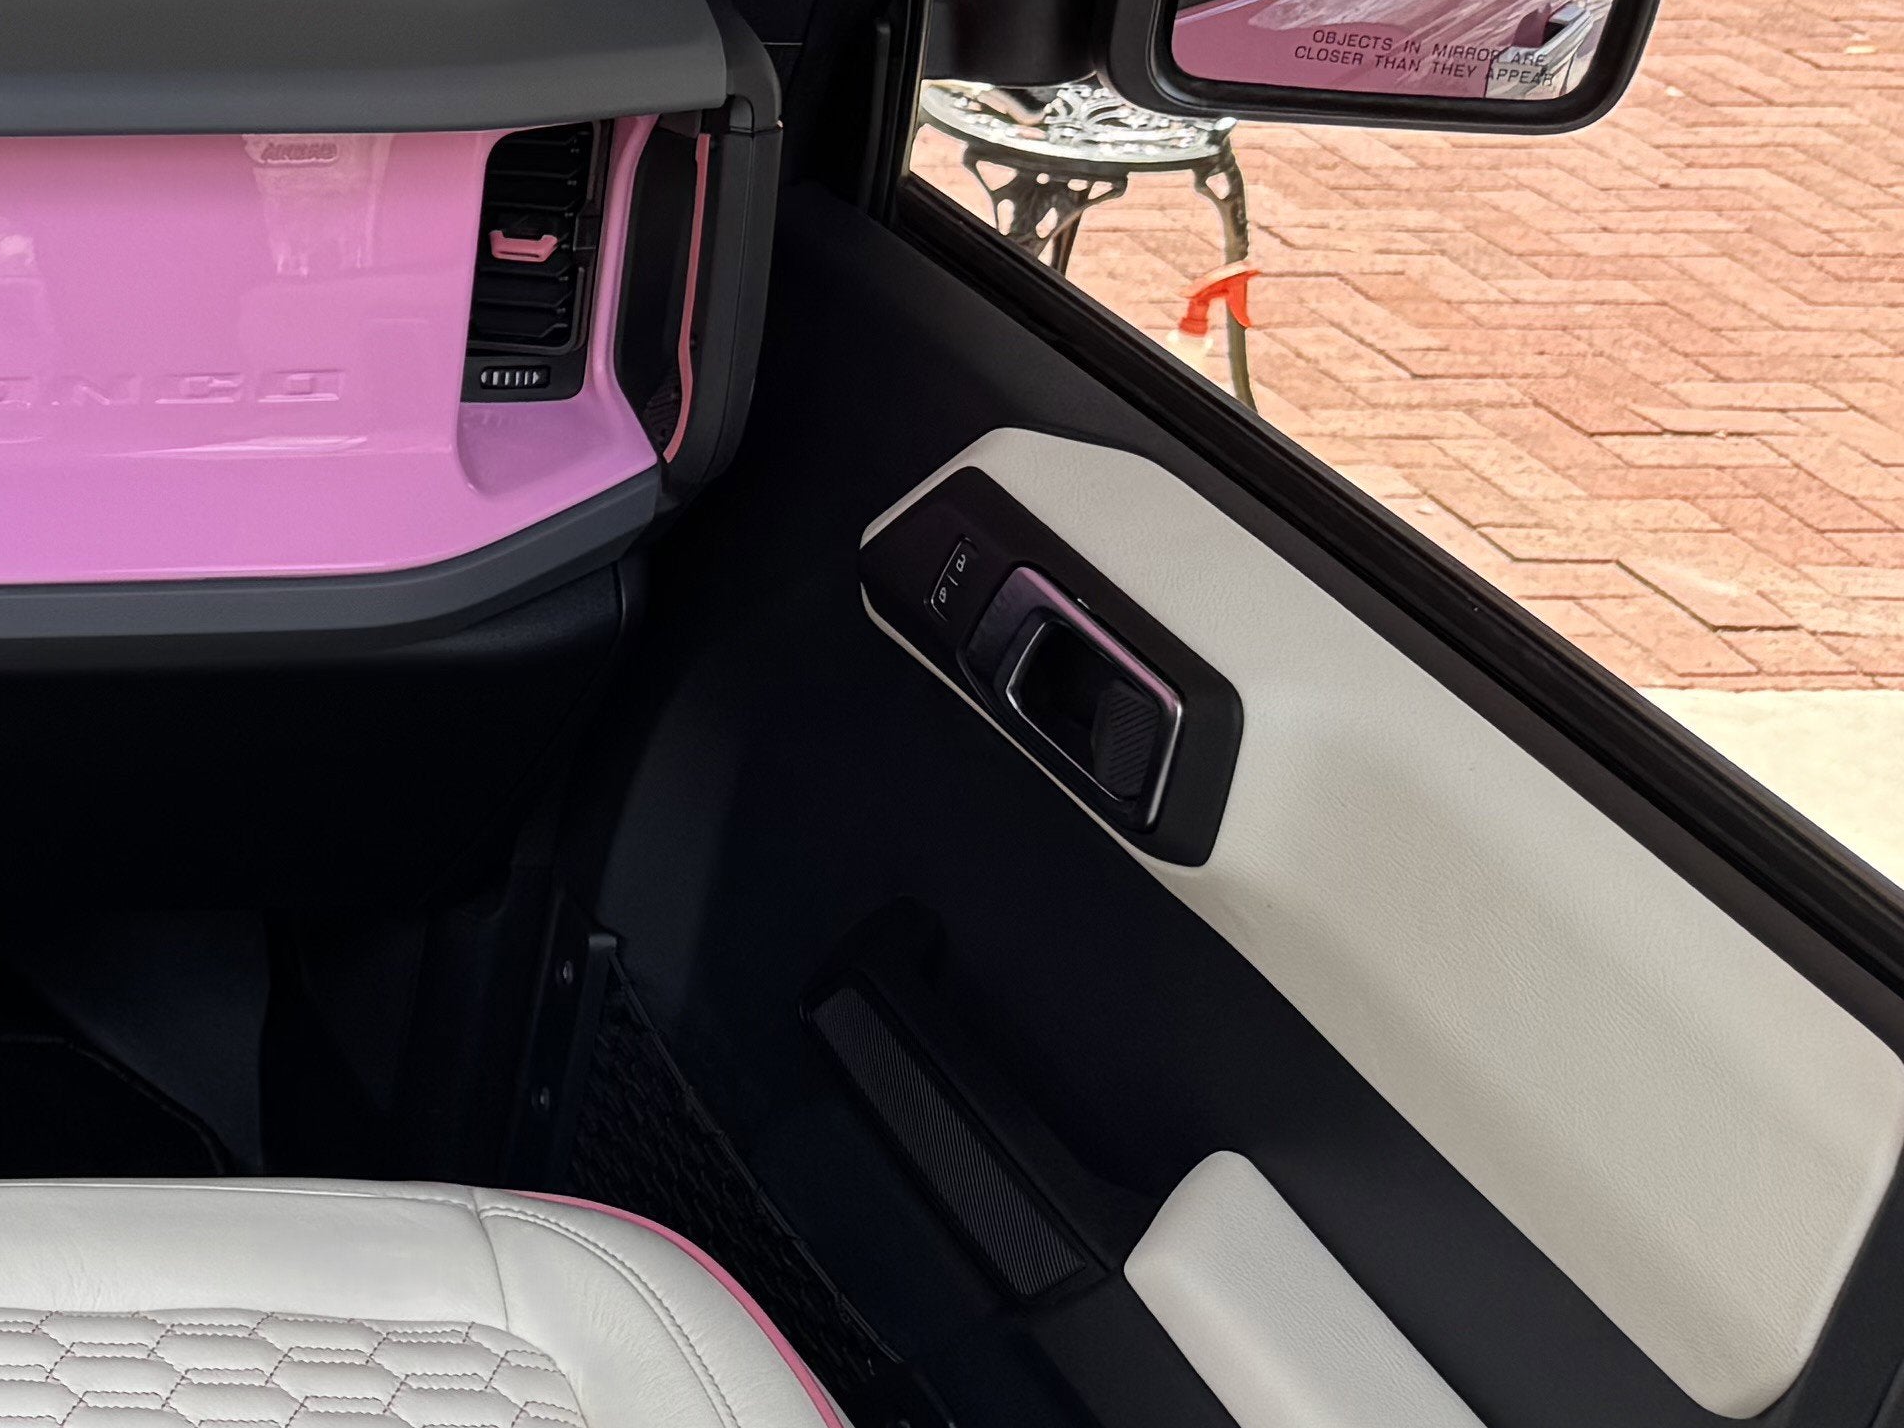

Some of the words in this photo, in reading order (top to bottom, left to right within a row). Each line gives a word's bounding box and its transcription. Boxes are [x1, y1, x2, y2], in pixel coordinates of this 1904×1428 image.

[1294, 46, 1363, 65] CLOSER
[1375, 55, 1420, 72] THAN
[1432, 61, 1477, 78] THEY
[1487, 68, 1553, 87] APPEAR
[1313, 29, 1393, 51] OBJECTS
[1404, 41, 1420, 54] IN
[1432, 43, 1500, 63] MIRROR
[1510, 52, 1546, 66] ARE
